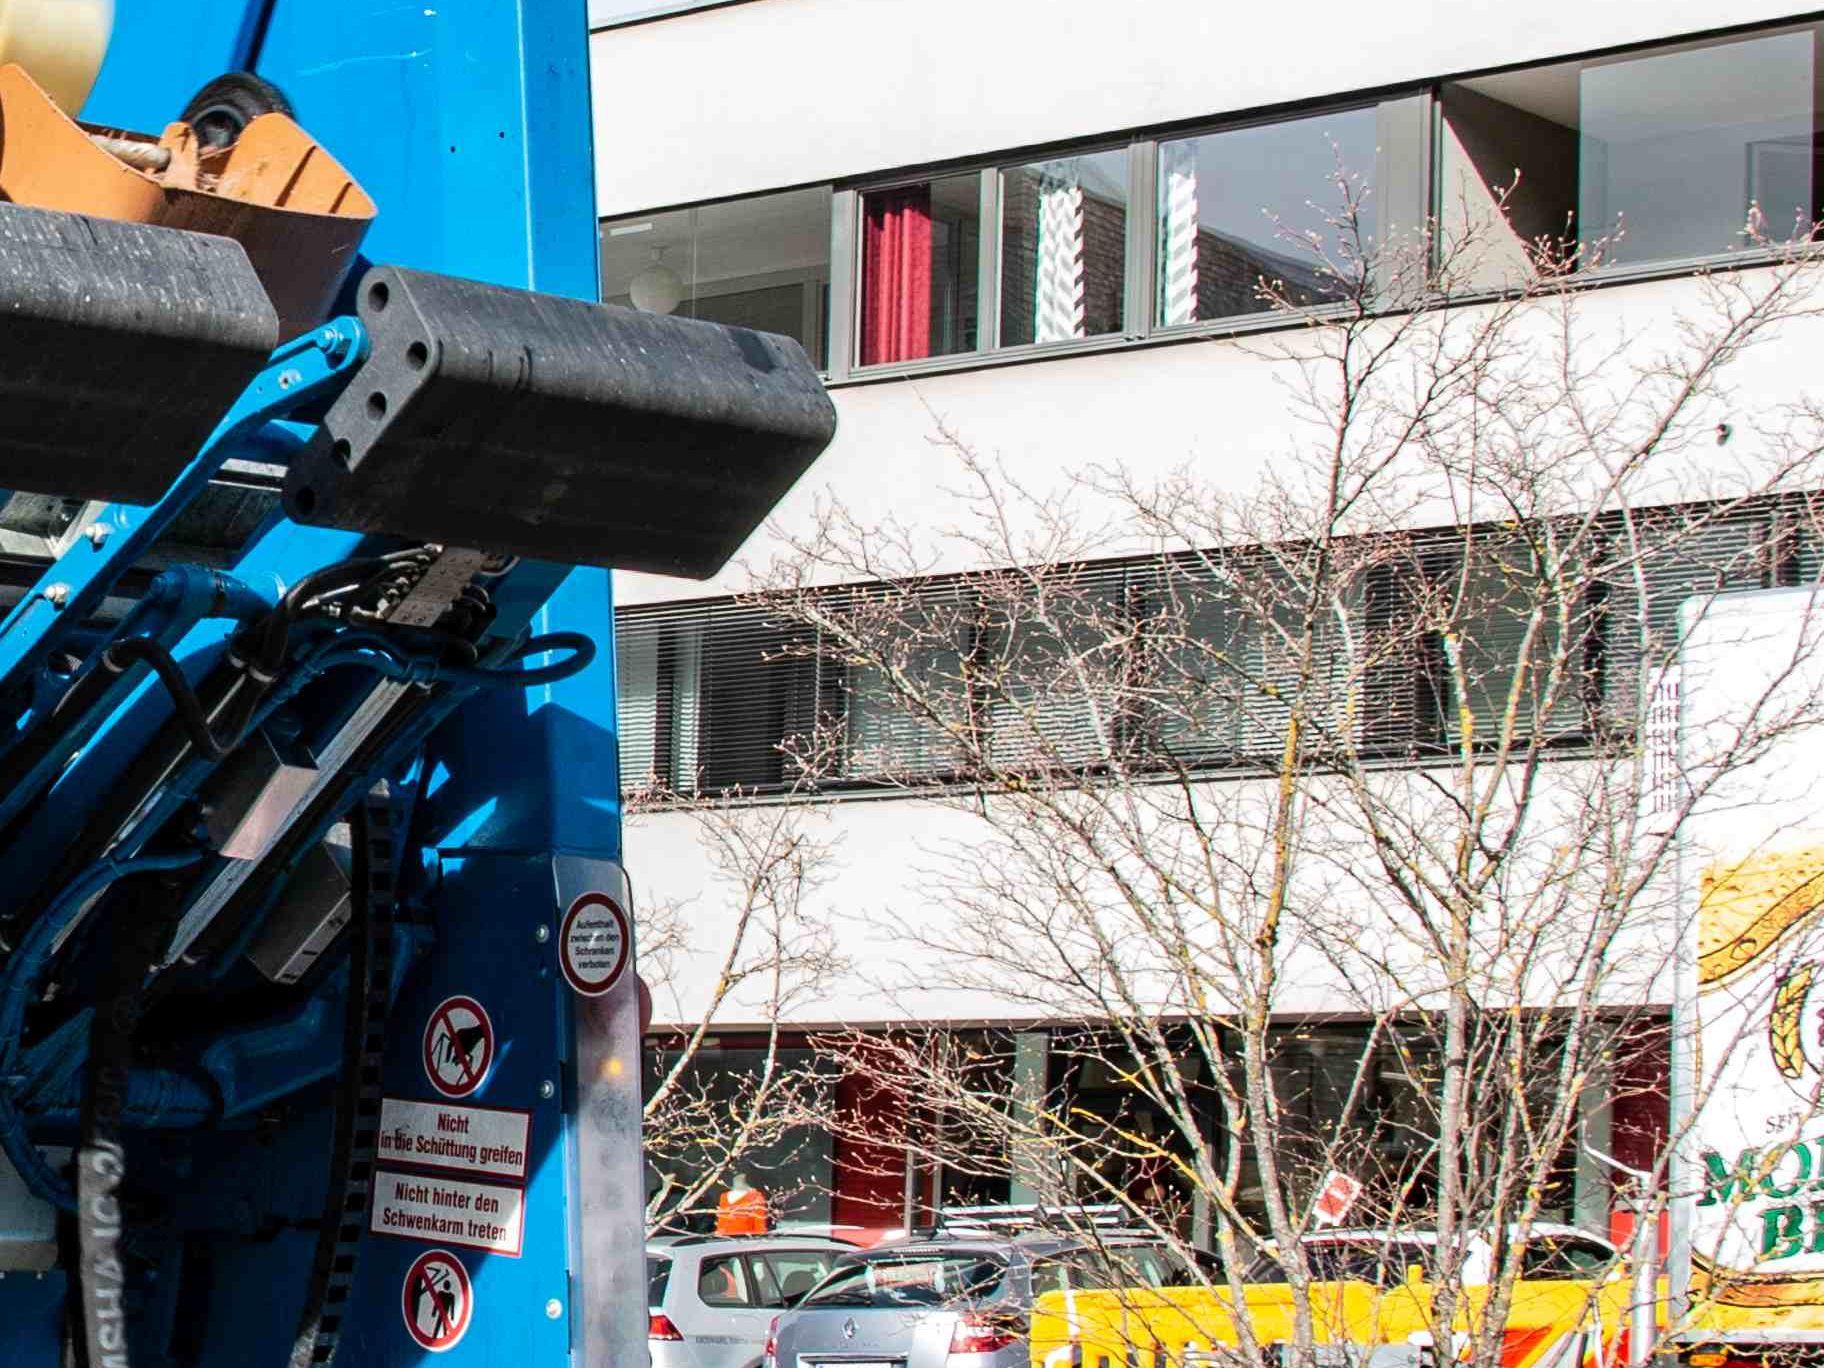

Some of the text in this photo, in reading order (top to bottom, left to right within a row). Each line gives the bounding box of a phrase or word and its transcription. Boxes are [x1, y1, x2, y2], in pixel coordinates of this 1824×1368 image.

[437, 1112, 469, 1134] Nicht
[380, 1130, 523, 1165] in die Schüttung greifen
[1696, 1138, 1824, 1207] MO
[395, 1181, 499, 1213] Nicht hinter den
[383, 1207, 507, 1241] Schwenkarm treten
